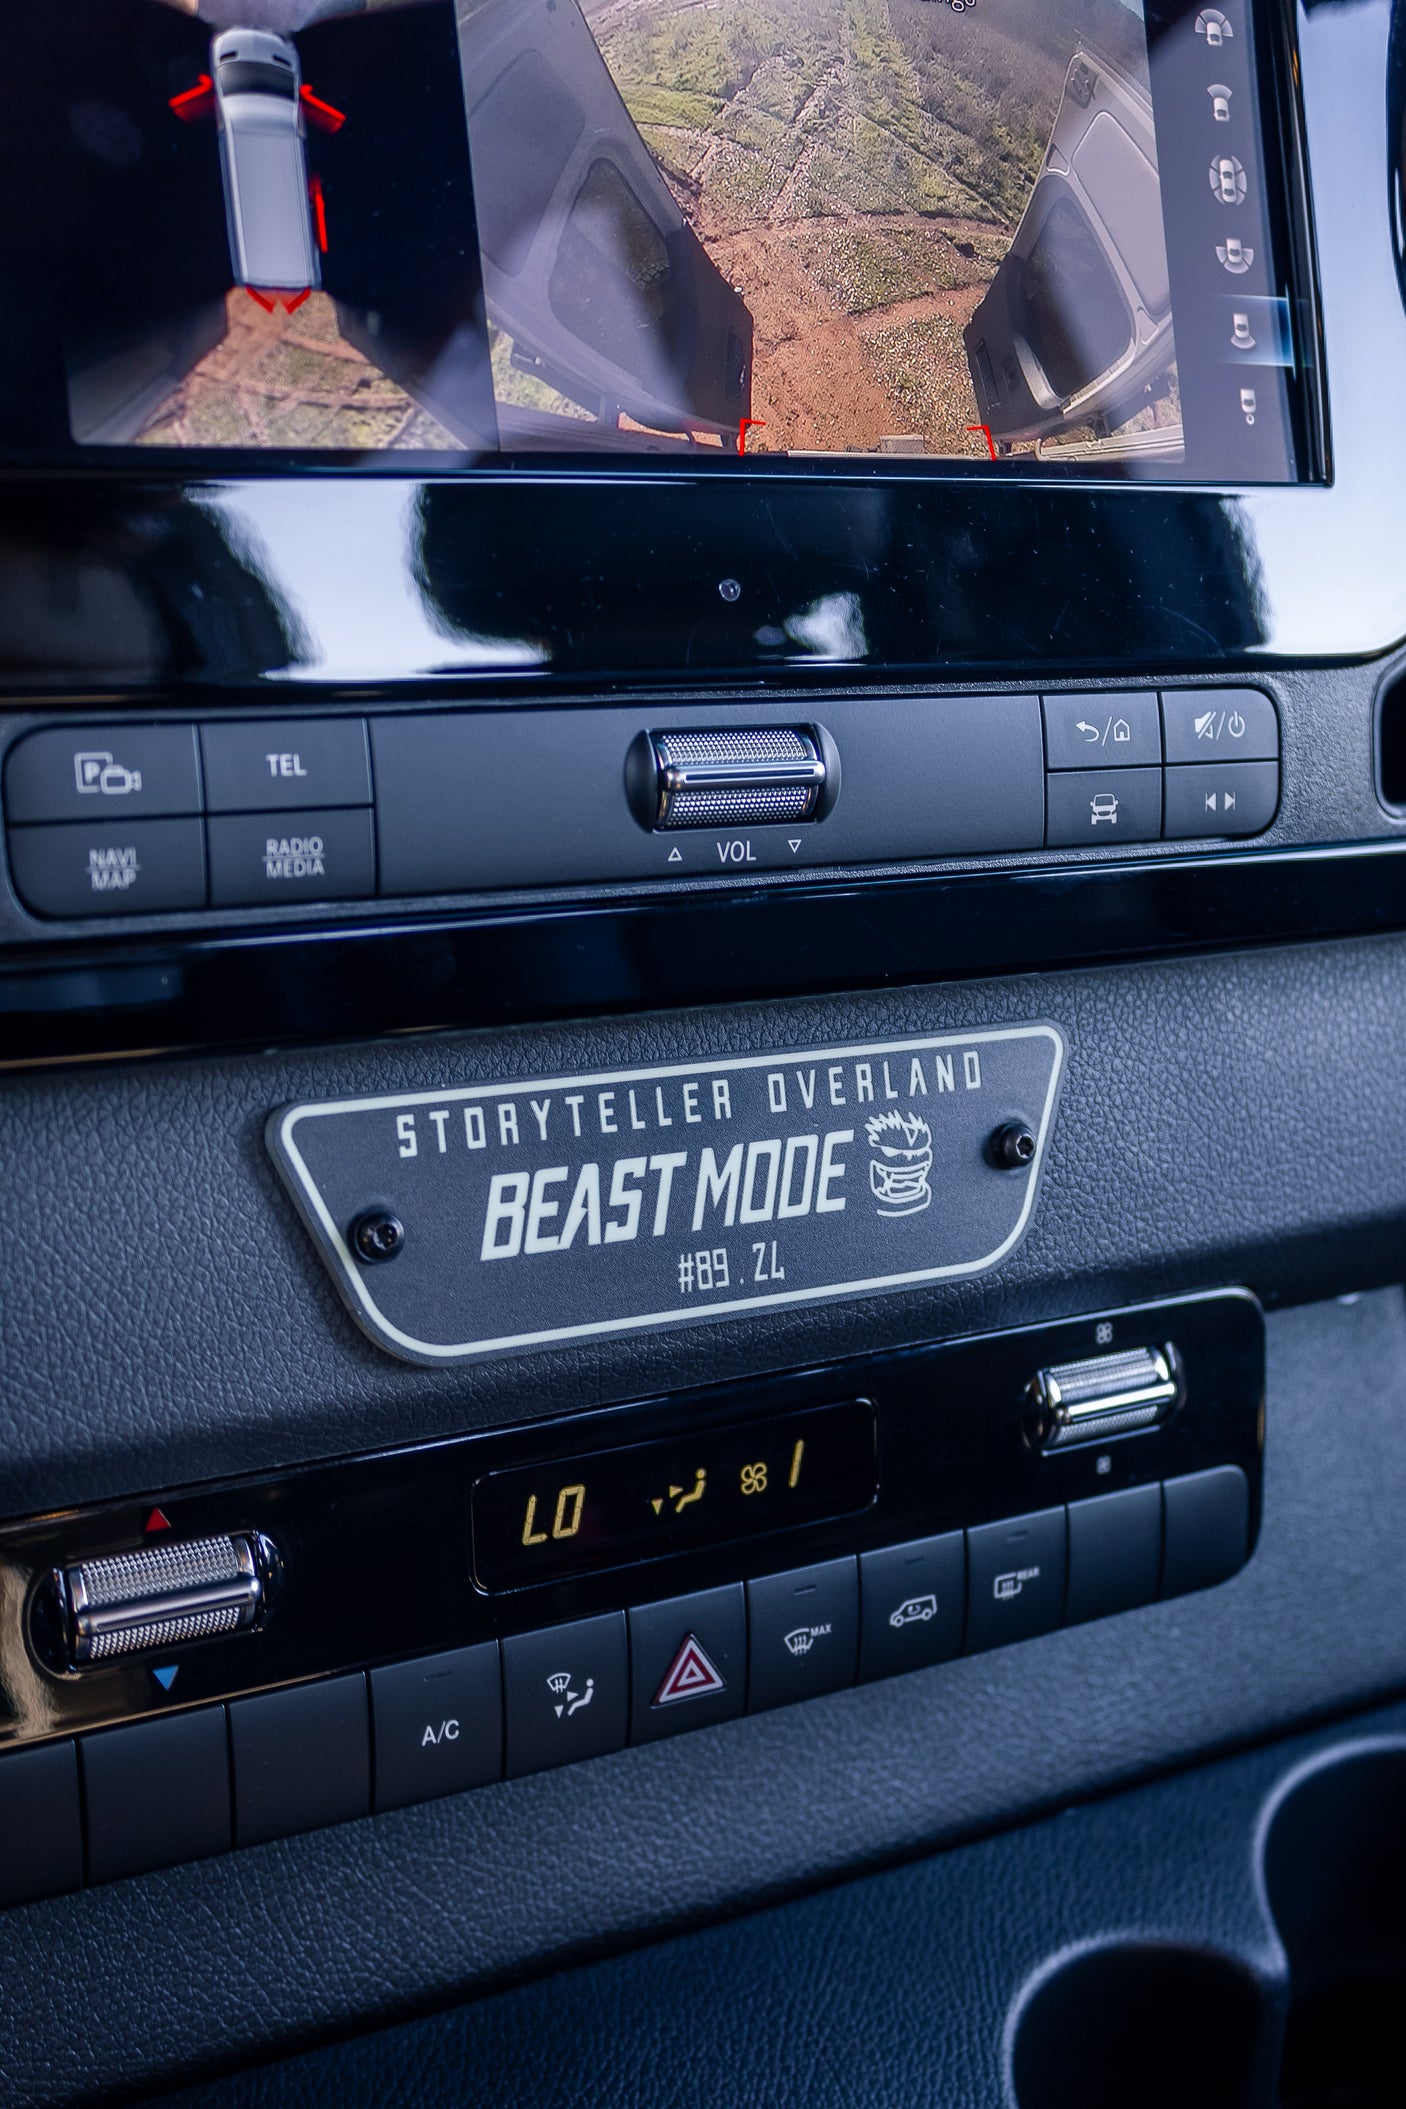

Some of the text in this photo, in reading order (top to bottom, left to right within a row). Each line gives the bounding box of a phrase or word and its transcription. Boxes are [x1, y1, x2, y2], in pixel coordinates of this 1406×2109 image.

[266, 753, 308, 777] TEL
[89, 847, 137, 867] NAVI
[265, 836, 324, 857] RADIO
[716, 840, 757, 863] VOL
[265, 856, 326, 879] MEDIA
[91, 869, 137, 891] MAP
[396, 1050, 982, 1158] STORYTELLER OVERLAND
[480, 1129, 855, 1262] BEAST MODE
[1016, 1566, 1041, 1581] REAR
[810, 1623, 832, 1638] MAX
[421, 1719, 460, 1747] A/C
